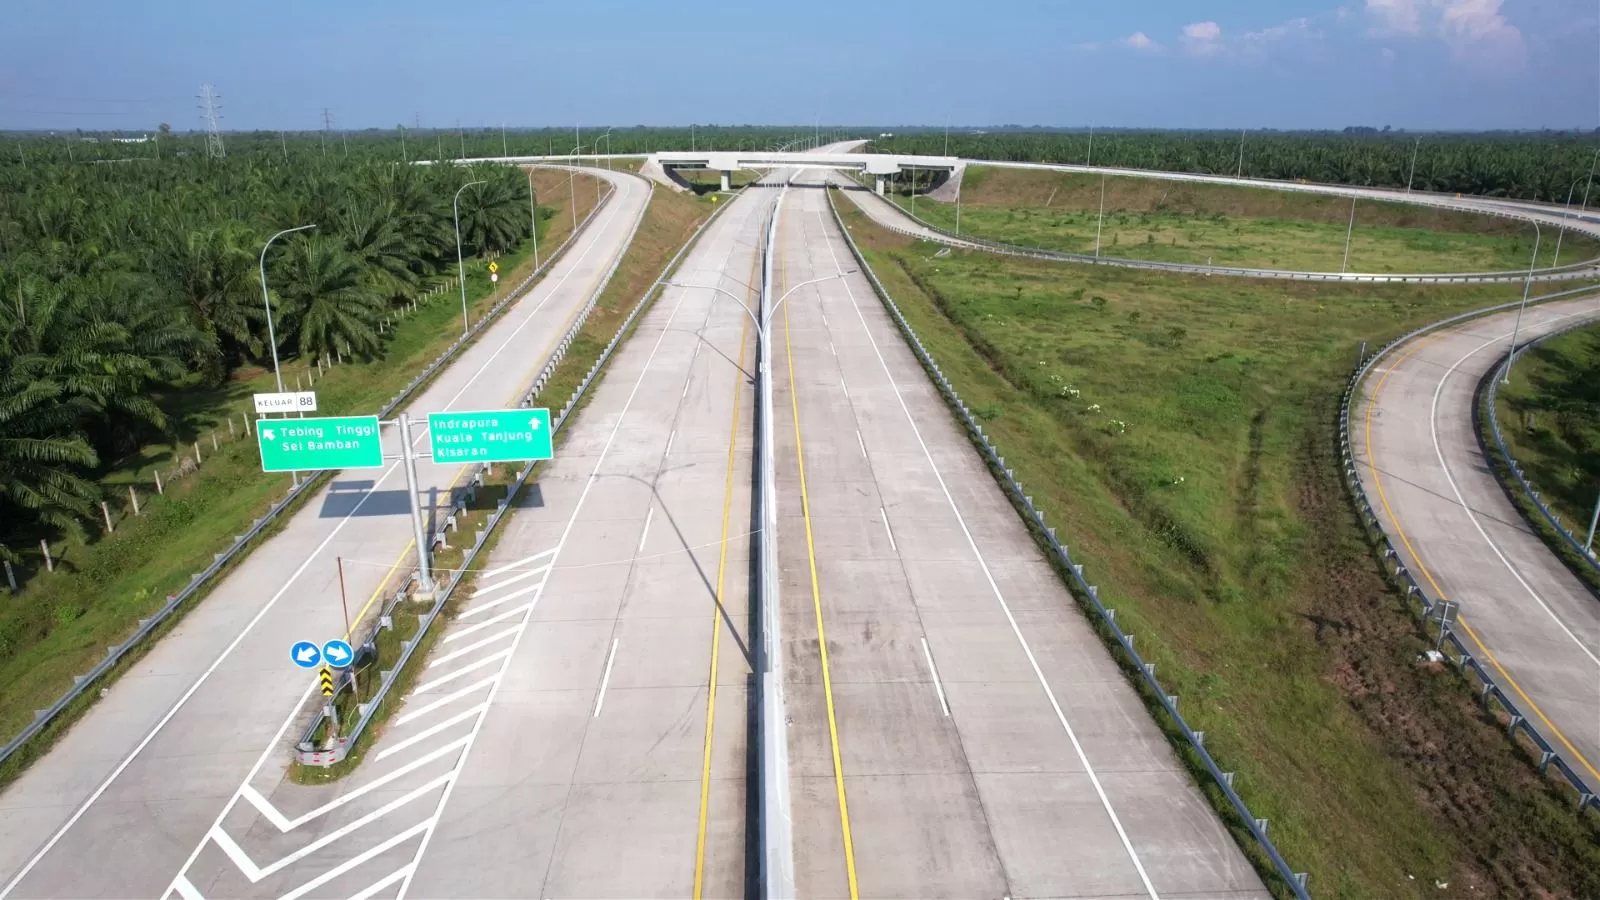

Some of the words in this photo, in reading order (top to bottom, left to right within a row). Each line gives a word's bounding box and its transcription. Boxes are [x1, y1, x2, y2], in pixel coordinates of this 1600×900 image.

[258, 398, 293, 407] KELUAR
[299, 397, 314, 406] 88
[434, 418, 499, 430] Indrapura
[280, 426, 324, 438] Tebing
[336, 424, 375, 437] Tinggi
[436, 433, 473, 444] Kuala
[481, 431, 533, 443] Tanjung
[282, 441, 303, 452] Sei
[307, 439, 360, 451] Bamban
[437, 447, 488, 458] Kisaran
